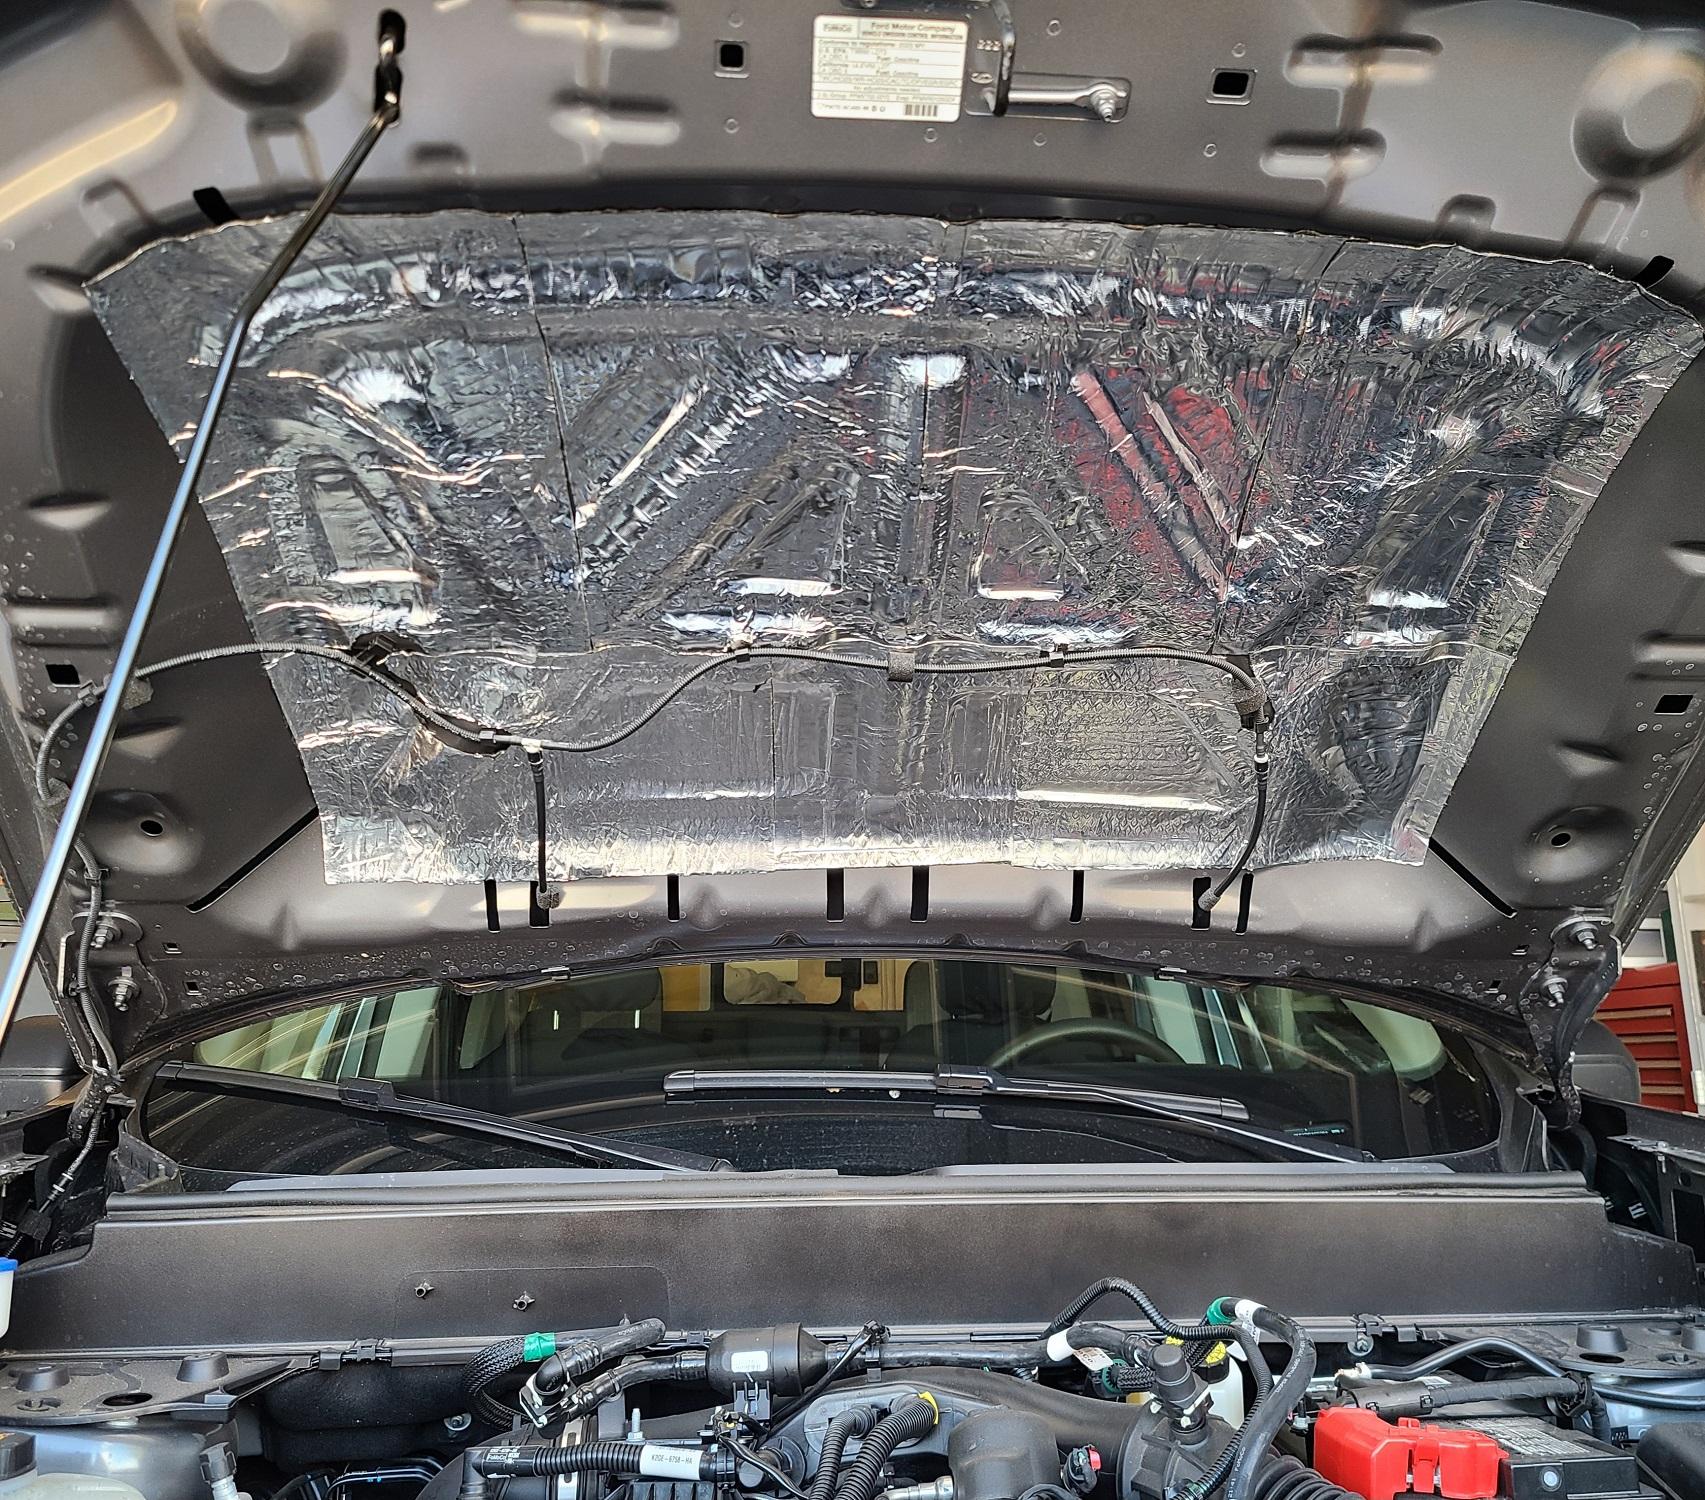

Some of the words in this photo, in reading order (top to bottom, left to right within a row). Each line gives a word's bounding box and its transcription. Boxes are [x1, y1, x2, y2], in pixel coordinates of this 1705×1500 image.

[871, 22, 889, 30] Ford
[891, 23, 916, 31] Motor
[917, 23, 955, 34] Company
